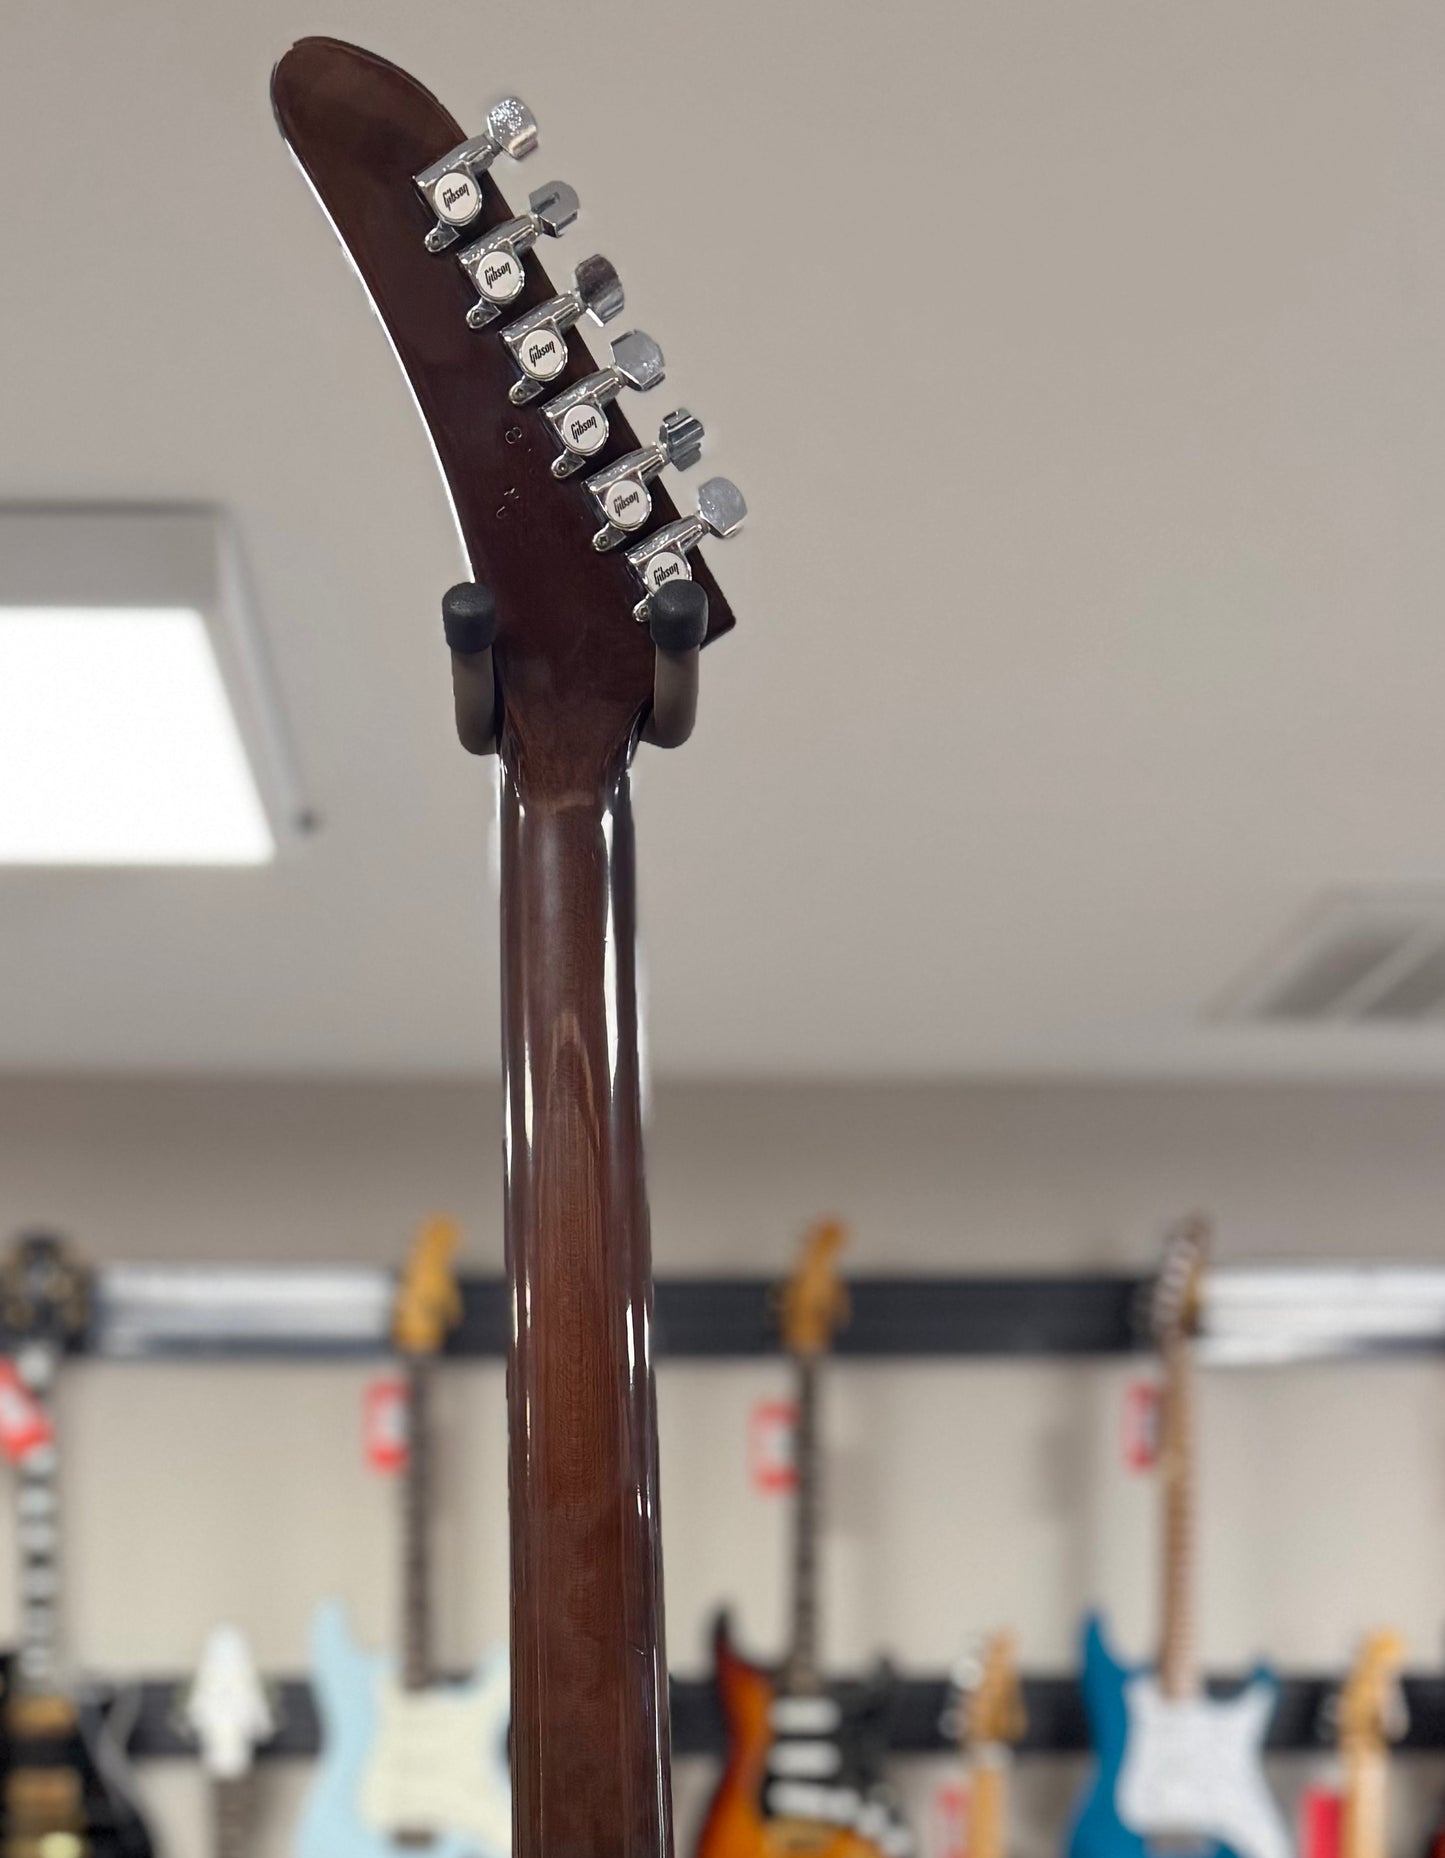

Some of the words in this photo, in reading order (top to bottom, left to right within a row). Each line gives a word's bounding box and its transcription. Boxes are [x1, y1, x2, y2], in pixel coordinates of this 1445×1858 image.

[442, 183, 470, 211] Gibson
[484, 262, 512, 289] Gibson
[528, 340, 556, 367] Gibson
[570, 415, 598, 443] Gibson
[613, 491, 640, 518] Gibson
[653, 562, 680, 588] Gibson
